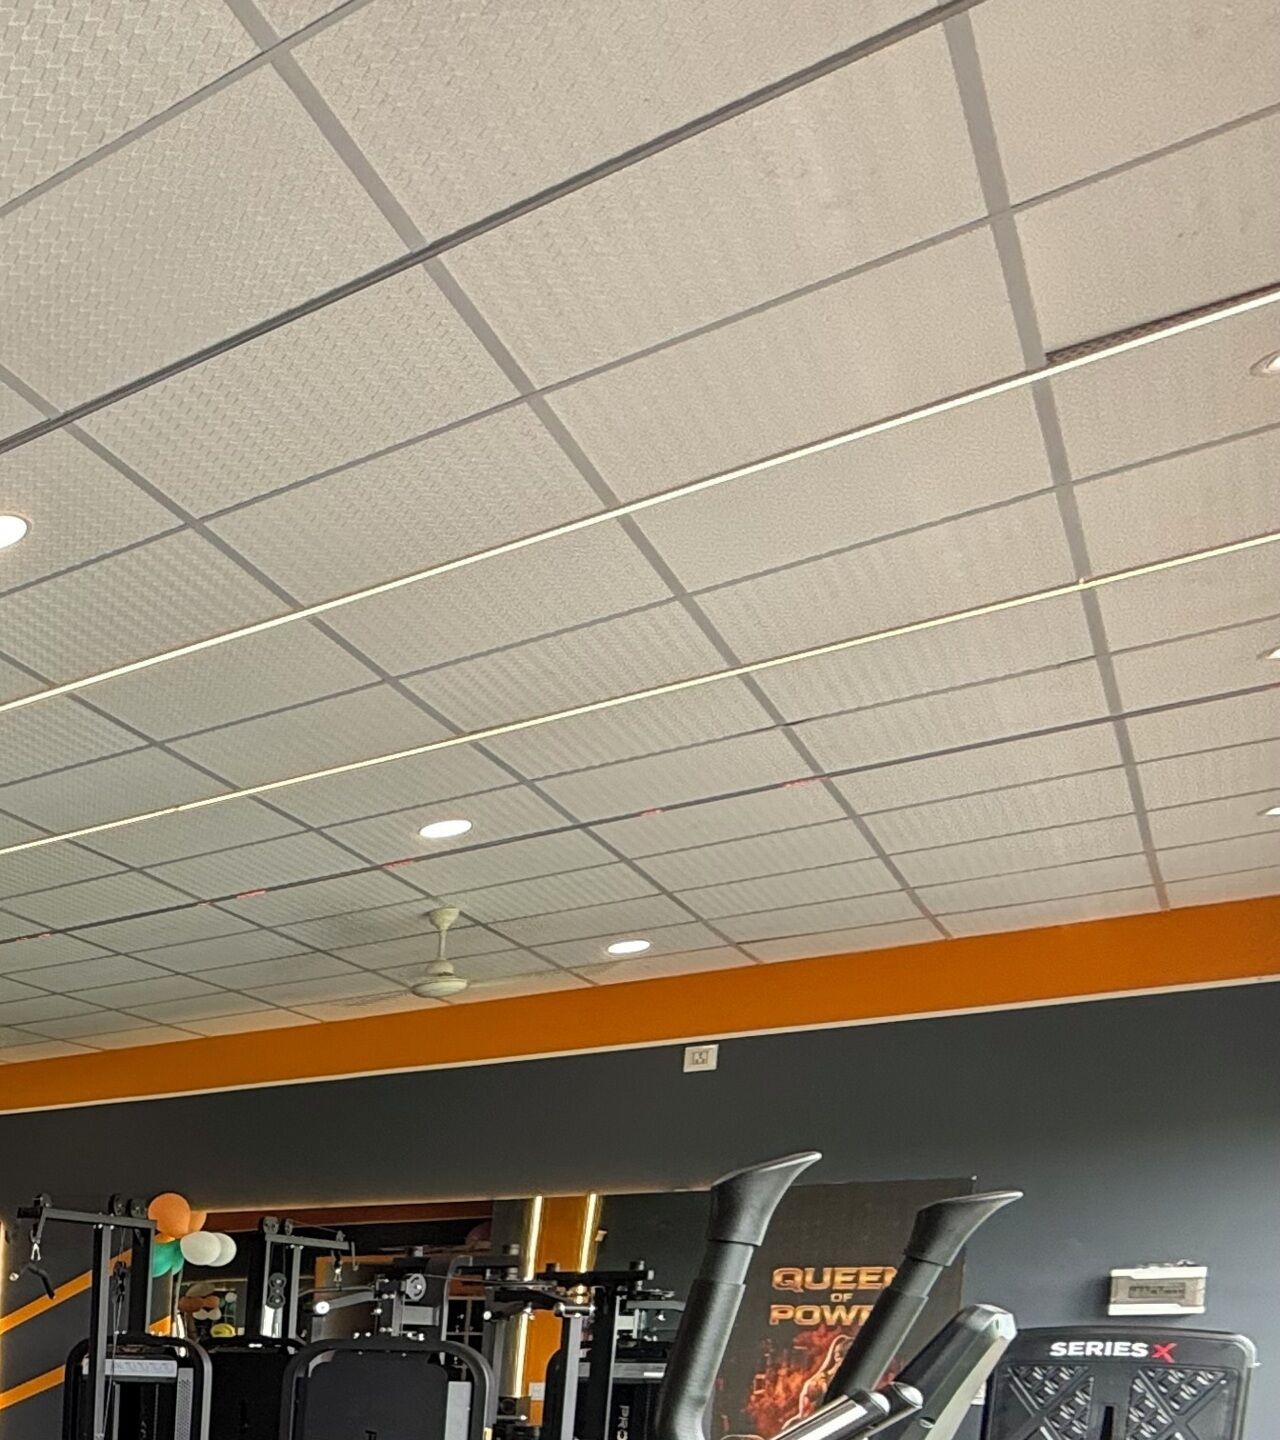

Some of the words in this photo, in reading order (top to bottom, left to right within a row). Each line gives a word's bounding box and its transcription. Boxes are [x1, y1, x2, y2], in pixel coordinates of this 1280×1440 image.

[830, 1292, 854, 1303] OF
[769, 1304, 874, 1326] POW
[1049, 1341, 1149, 1358] SERIES
